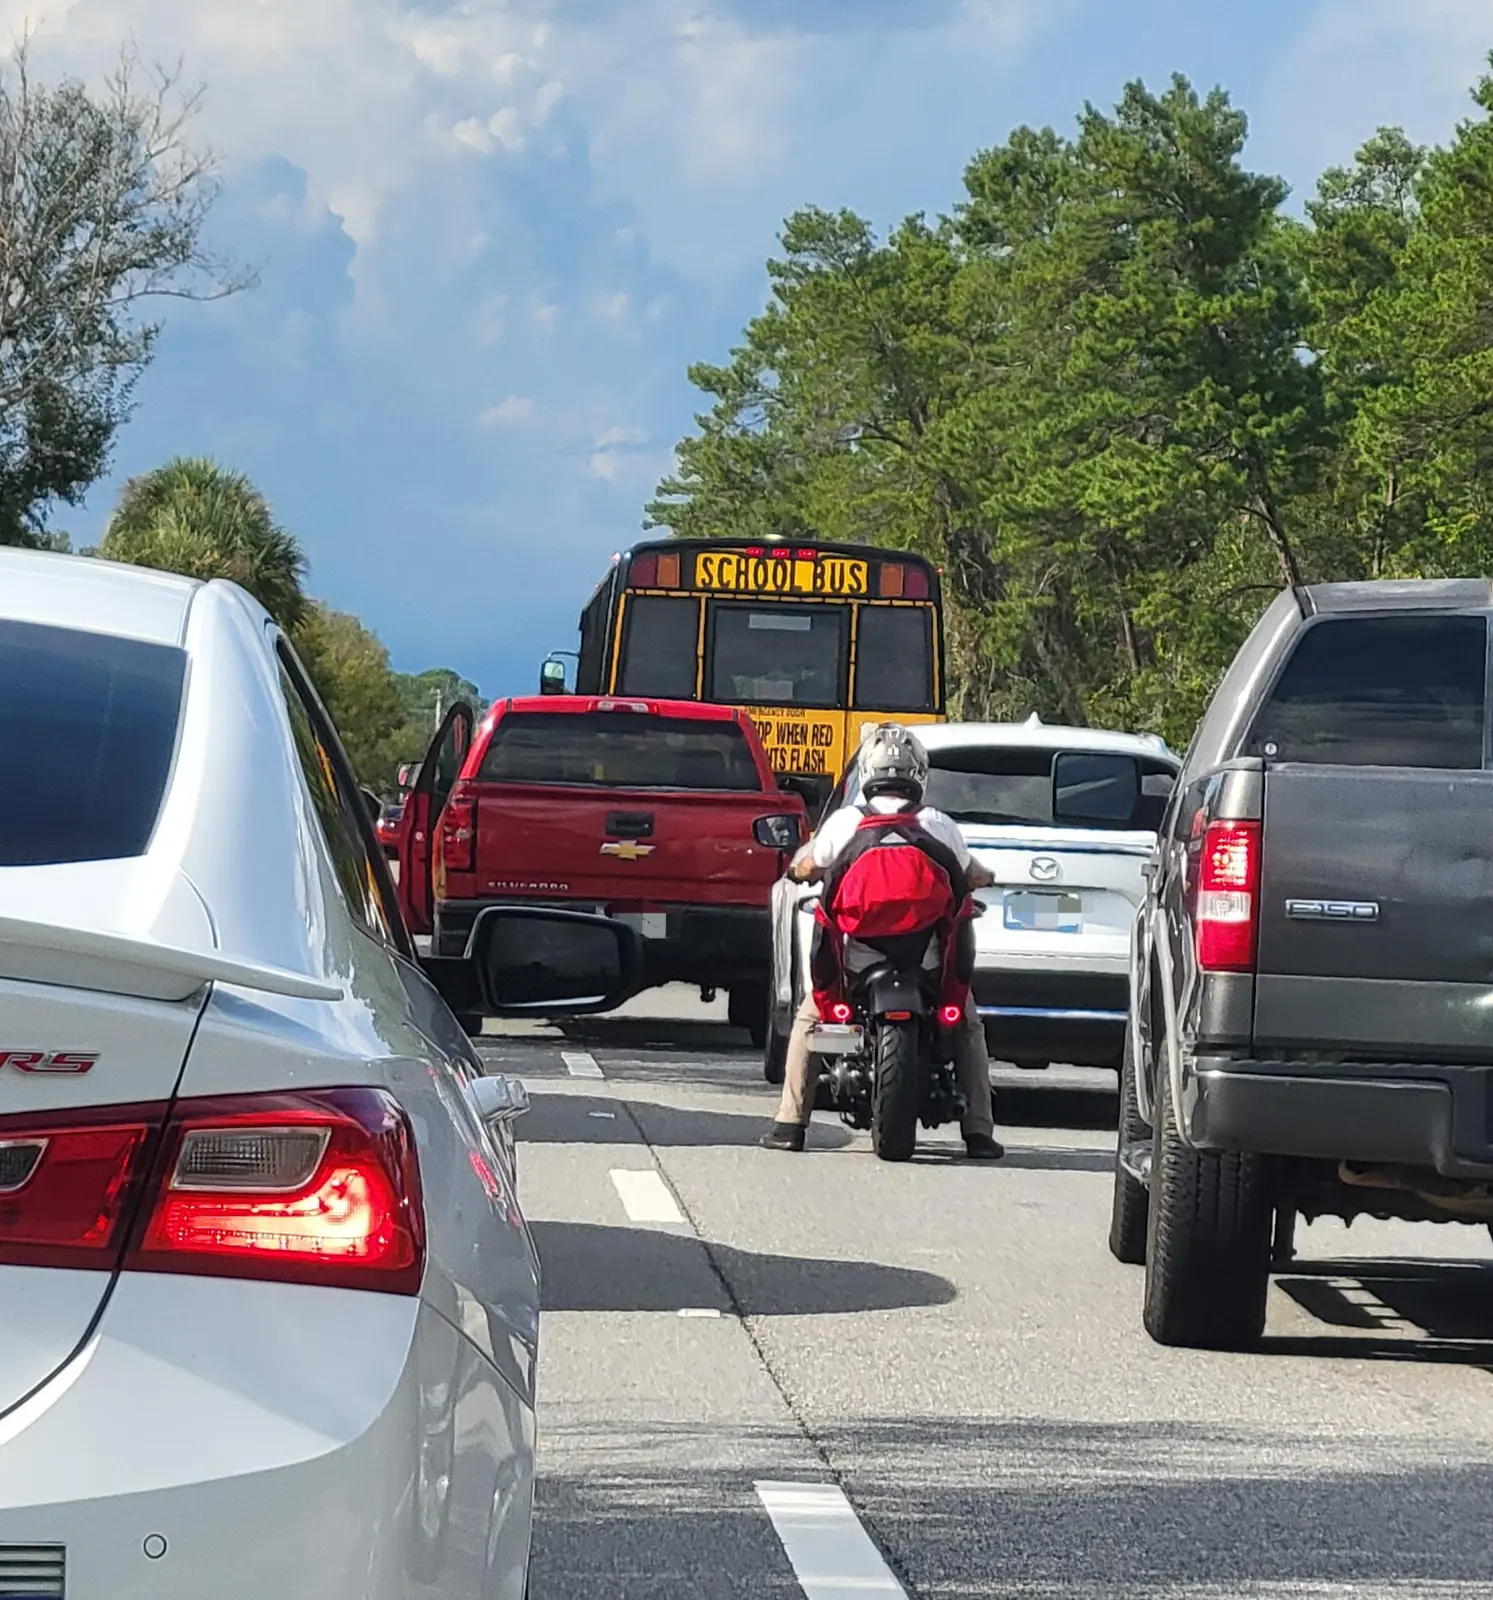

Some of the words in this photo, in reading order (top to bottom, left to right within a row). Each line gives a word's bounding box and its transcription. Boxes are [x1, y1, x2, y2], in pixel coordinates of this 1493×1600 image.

[701, 556, 803, 591] SCHOOL
[813, 559, 863, 594] BUS
[776, 721, 808, 746] WHEN
[811, 724, 834, 747] RED
[790, 748, 826, 773] FLASH
[0, 1050, 100, 1074] RS
